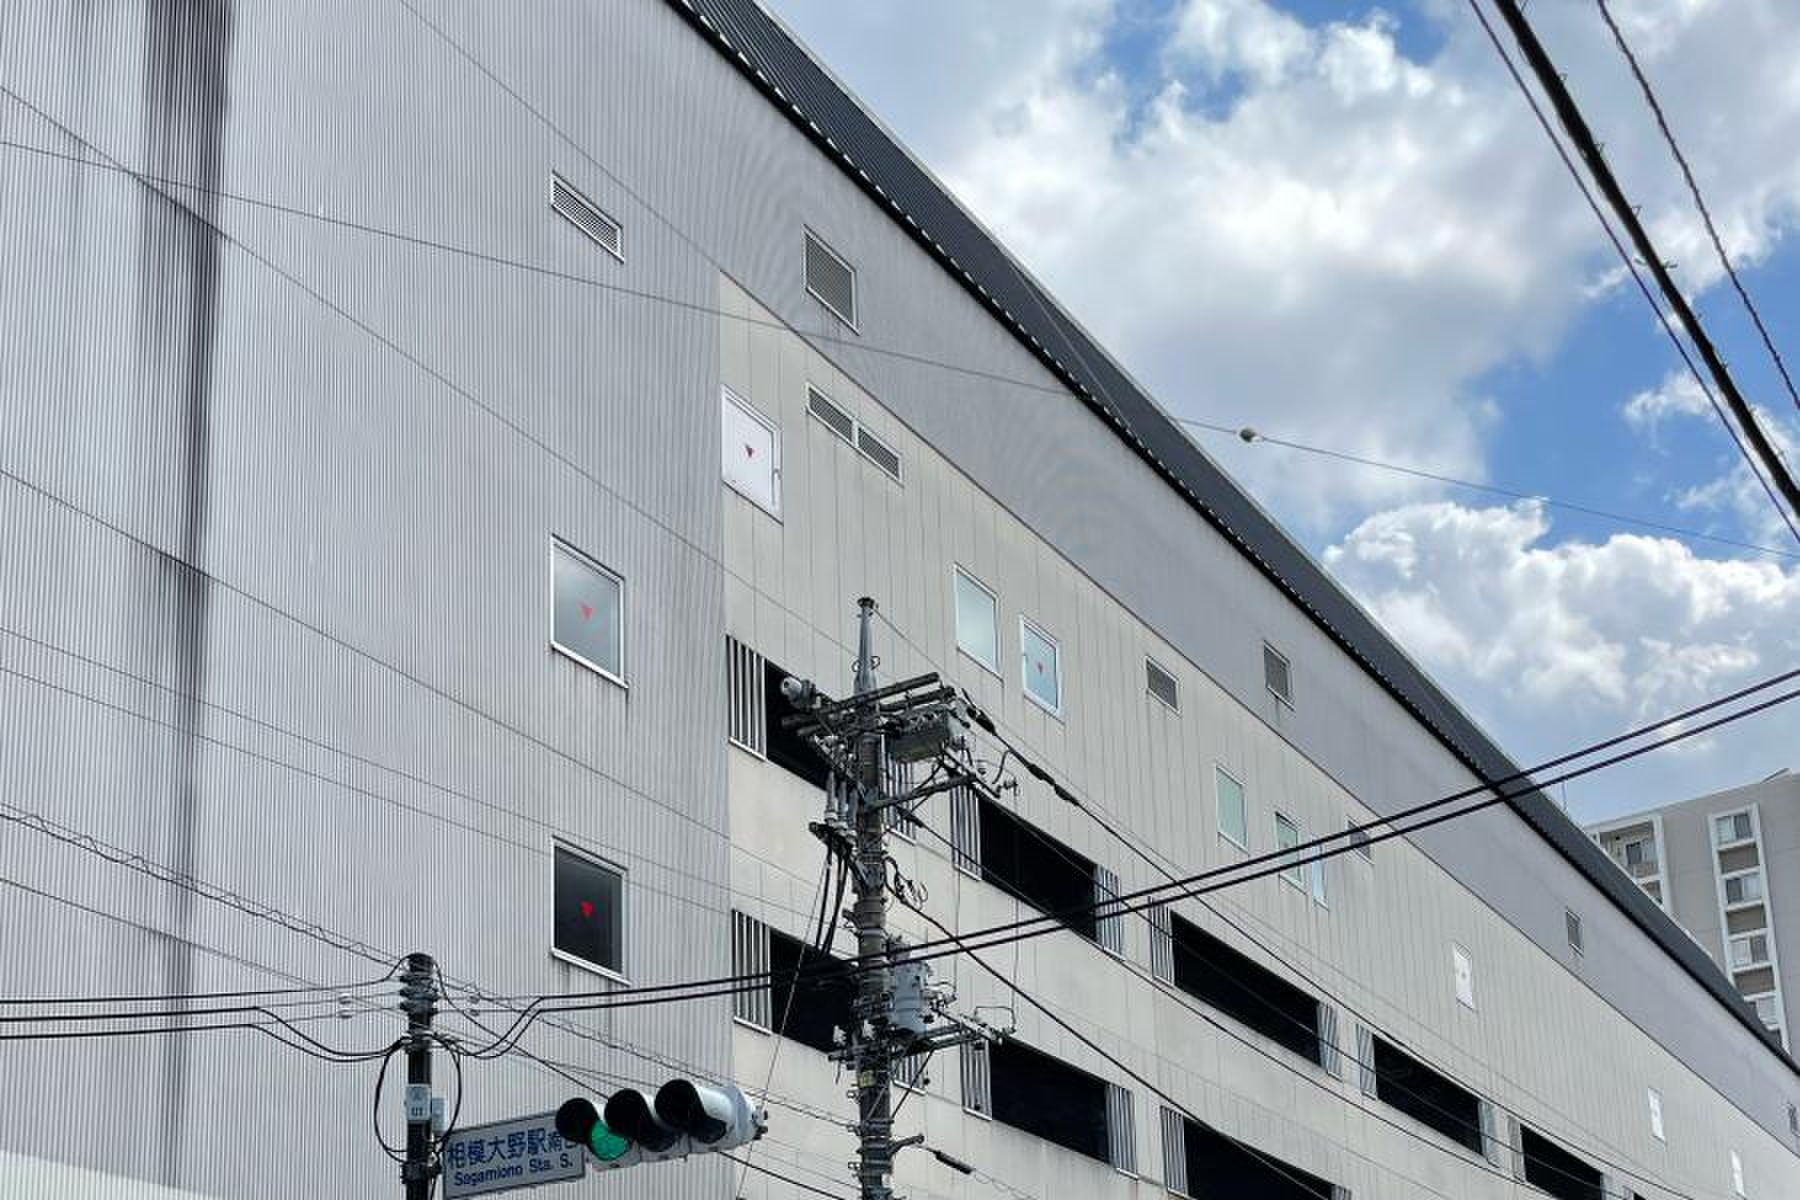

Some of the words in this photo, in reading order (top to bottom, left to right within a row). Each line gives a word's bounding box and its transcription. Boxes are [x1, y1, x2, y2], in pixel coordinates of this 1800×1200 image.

[454, 1165, 523, 1187] Sagamiono
[529, 1158, 554, 1174] Sta.
[560, 1153, 573, 1168] S.
